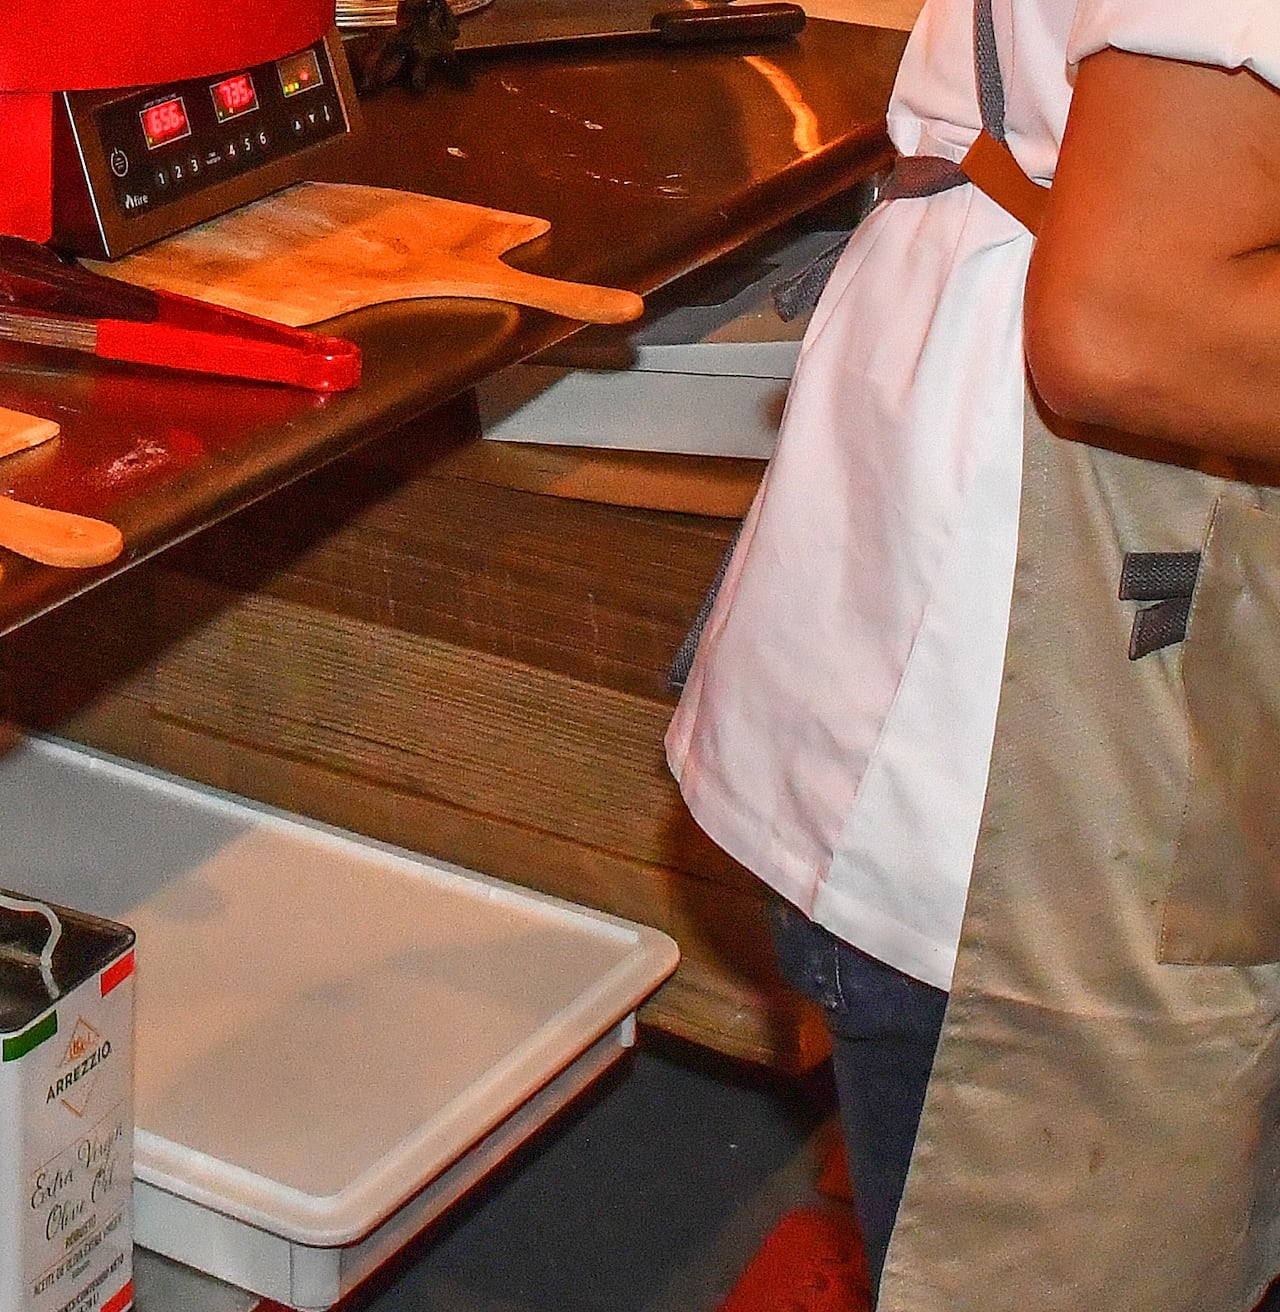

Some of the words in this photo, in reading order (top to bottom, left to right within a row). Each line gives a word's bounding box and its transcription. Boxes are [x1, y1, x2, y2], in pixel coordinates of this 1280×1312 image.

[244, 138, 251, 151] 5
[260, 132, 267, 145] 6
[228, 144, 236, 157] 4
[175, 165, 183, 179] 2
[191, 159, 199, 172] 3
[158, 172, 165, 185] 1
[133, 194, 149, 207] fire
[46, 1040, 111, 1104] ARREZZIO
[31, 1170, 73, 1208] Extra
